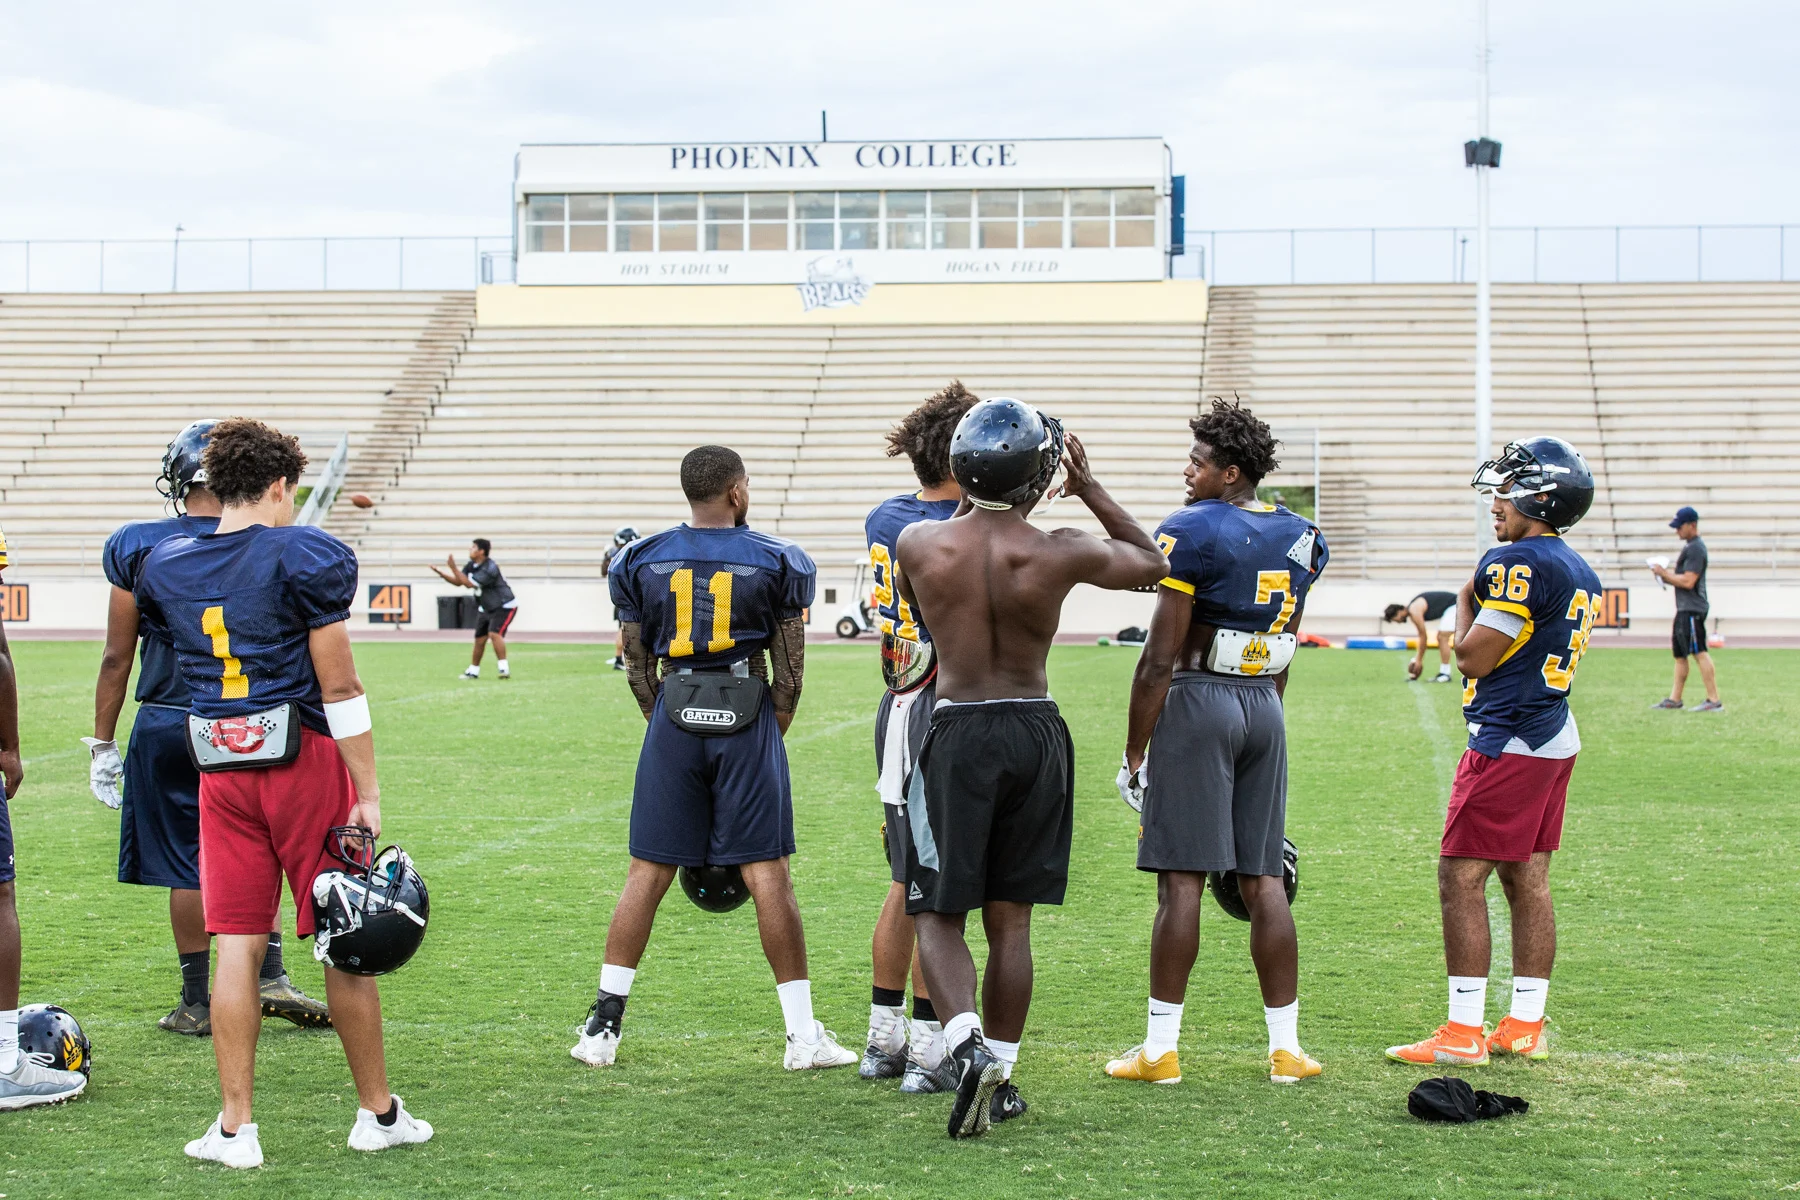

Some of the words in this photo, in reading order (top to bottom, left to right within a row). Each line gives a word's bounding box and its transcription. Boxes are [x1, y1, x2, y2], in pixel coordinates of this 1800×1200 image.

[671, 145, 820, 169] PHOENIX
[856, 143, 1017, 168] COLLEGE
[620, 263, 651, 275] HOY
[659, 263, 729, 275] STADIUM
[945, 261, 1001, 273] HOGAN
[1011, 261, 1059, 273] FIELD
[796, 281, 870, 312] BEARS
[1486, 563, 1532, 601] 36
[371, 586, 409, 622] 40
[669, 568, 735, 657] 11
[1254, 570, 1297, 635] 7
[201, 606, 249, 699] 1
[686, 711, 731, 723] BATTLE
[1511, 1034, 1533, 1054] NIKE
